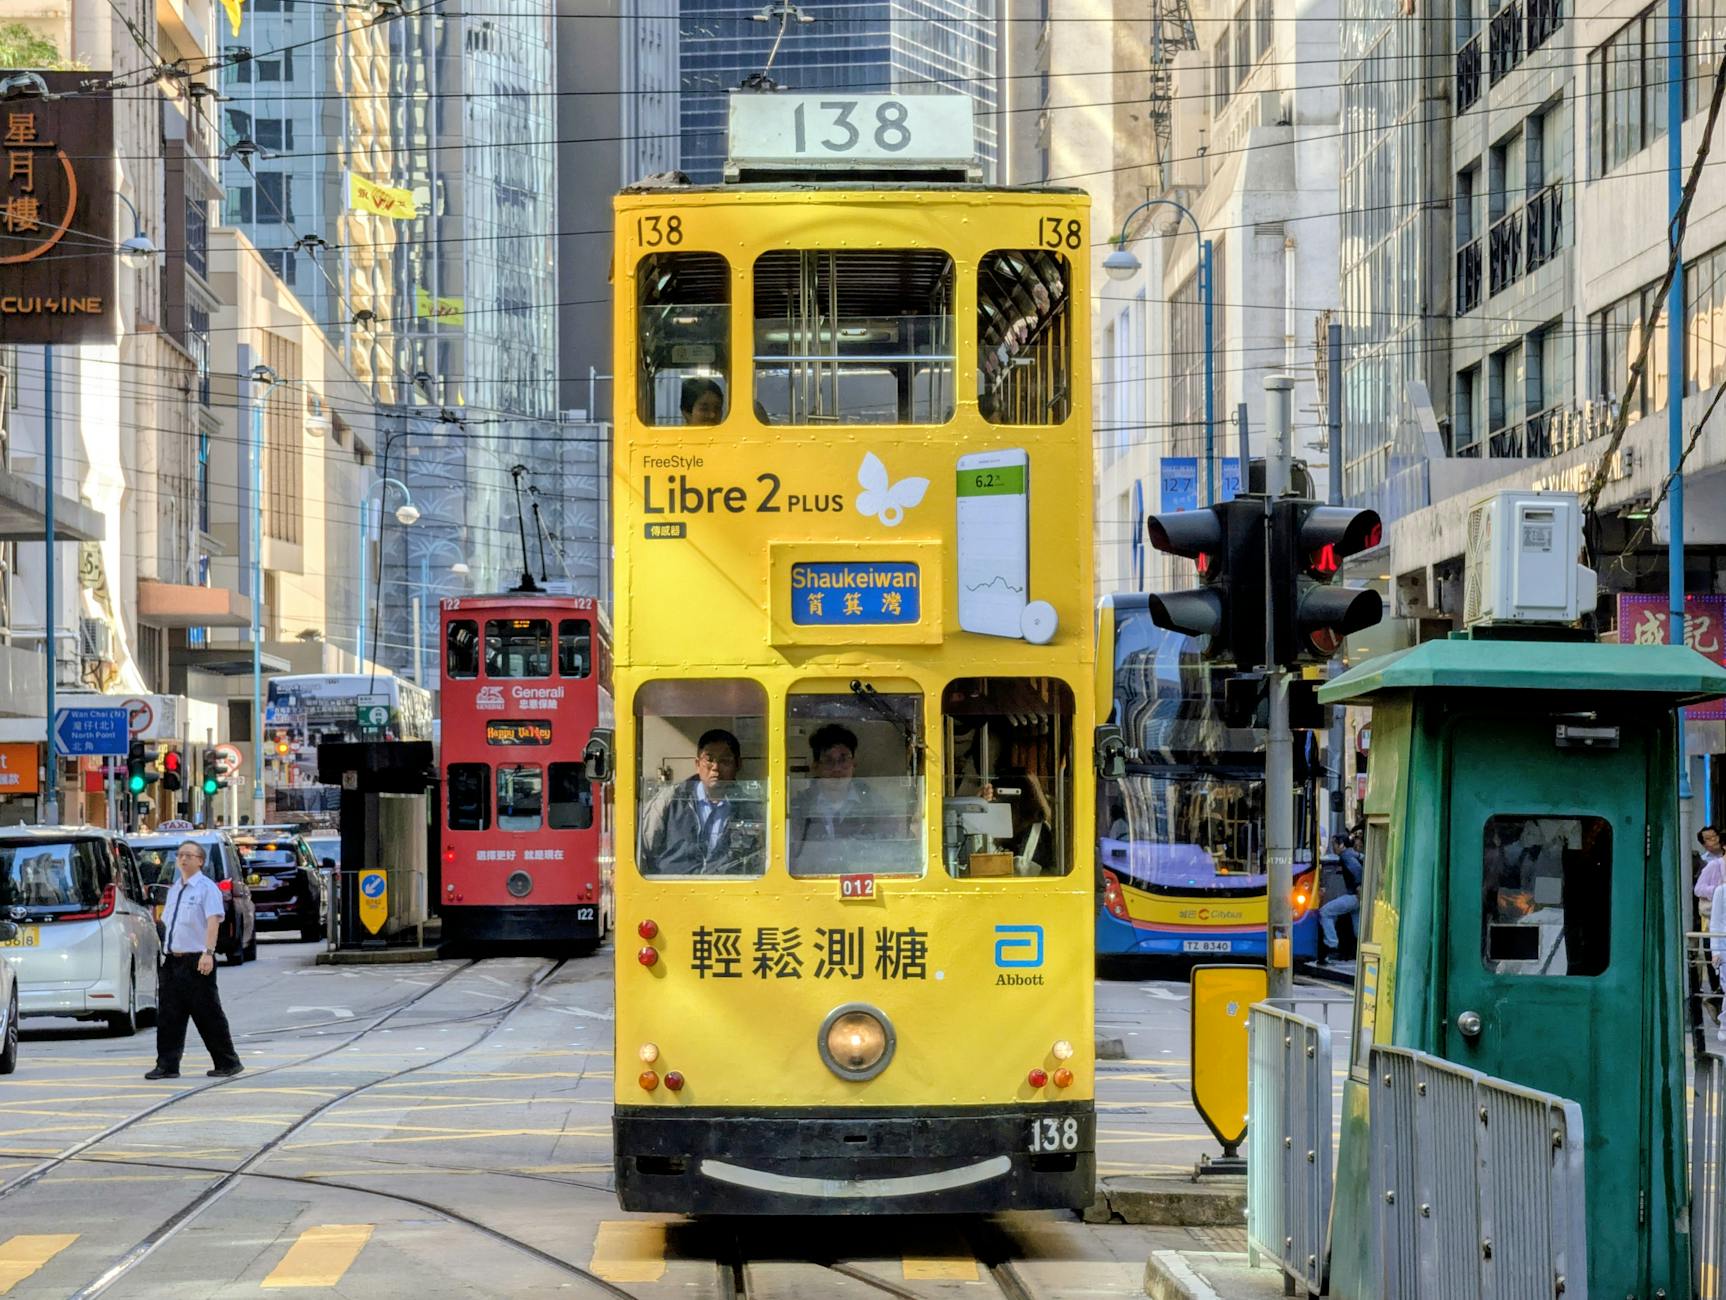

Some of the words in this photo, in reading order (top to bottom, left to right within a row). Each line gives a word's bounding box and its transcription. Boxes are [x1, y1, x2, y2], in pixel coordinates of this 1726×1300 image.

[794, 101, 912, 153] 138
[637, 215, 683, 247] 138
[1039, 216, 1082, 249] 138
[643, 455, 704, 470] FreeStyle
[975, 474, 994, 488] 6.2
[644, 474, 747, 514] Libre
[756, 472, 781, 513] 2
[788, 494, 844, 513] PLUS
[650, 525, 681, 537] 傳感器
[792, 567, 917, 589] Shaukeiwan
[443, 598, 460, 610] 122
[574, 598, 592, 610] 122
[807, 591, 902, 616] 筲箕灣
[512, 686, 564, 698] Generali
[487, 726, 515, 740] Happy
[163, 821, 190, 829] TAXI
[842, 879, 874, 897] 012
[577, 908, 594, 920] 122
[1187, 940, 1199, 950] TZ
[1202, 940, 1228, 950] 8340
[690, 925, 929, 980] 輕鬆測糖
[995, 974, 1045, 986] Abbott
[1032, 1117, 1078, 1152] 138
